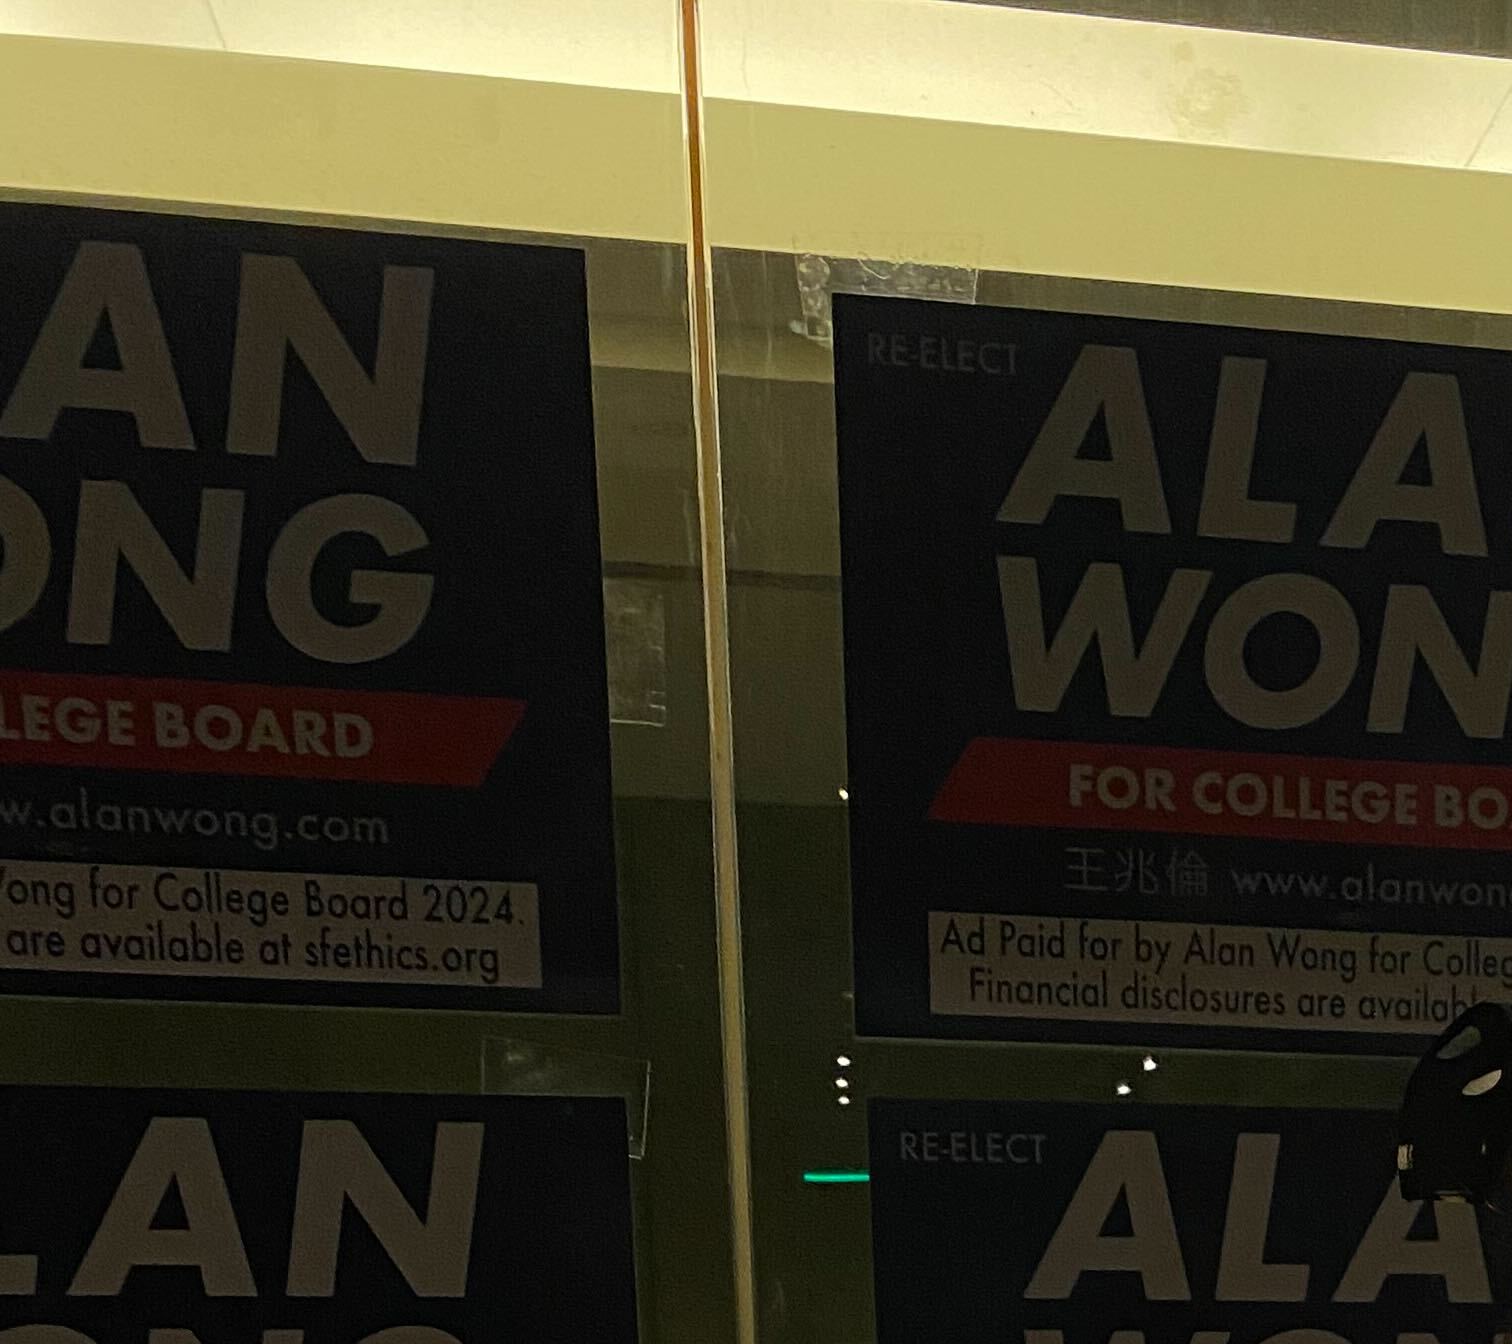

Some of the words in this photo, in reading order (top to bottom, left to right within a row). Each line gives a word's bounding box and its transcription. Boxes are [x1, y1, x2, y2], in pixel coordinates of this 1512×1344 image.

[0, 240, 435, 467] AN
[868, 332, 1017, 376] RE-ELECT
[153, 699, 374, 759] BOARD
[1068, 763, 1175, 813] FOR
[1192, 769, 1417, 826] COLLEGE
[0, 864, 75, 918] ong
[89, 866, 139, 909] for
[154, 872, 290, 927] College
[306, 878, 407, 921] Board
[424, 884, 525, 927] 2024.
[1063, 845, 1211, 897] 王兆倫
[7, 929, 65, 958] are
[81, 922, 243, 965] available
[260, 934, 291, 967] at
[306, 926, 500, 983] sfethics.org
[940, 918, 985, 957] Ad
[1000, 921, 1067, 962] Paid
[1078, 920, 1121, 964] for
[1134, 926, 1170, 974] by
[1184, 928, 1255, 967] Alan
[1267, 934, 1357, 982] Wong
[1369, 936, 1411, 975] for
[969, 966, 1110, 1010] Financial
[1121, 971, 1286, 1018] disclosures
[1299, 986, 1346, 1020] are
[1359, 986, 1476, 1022] availab
[900, 1131, 1049, 1165] RE-ELECT
